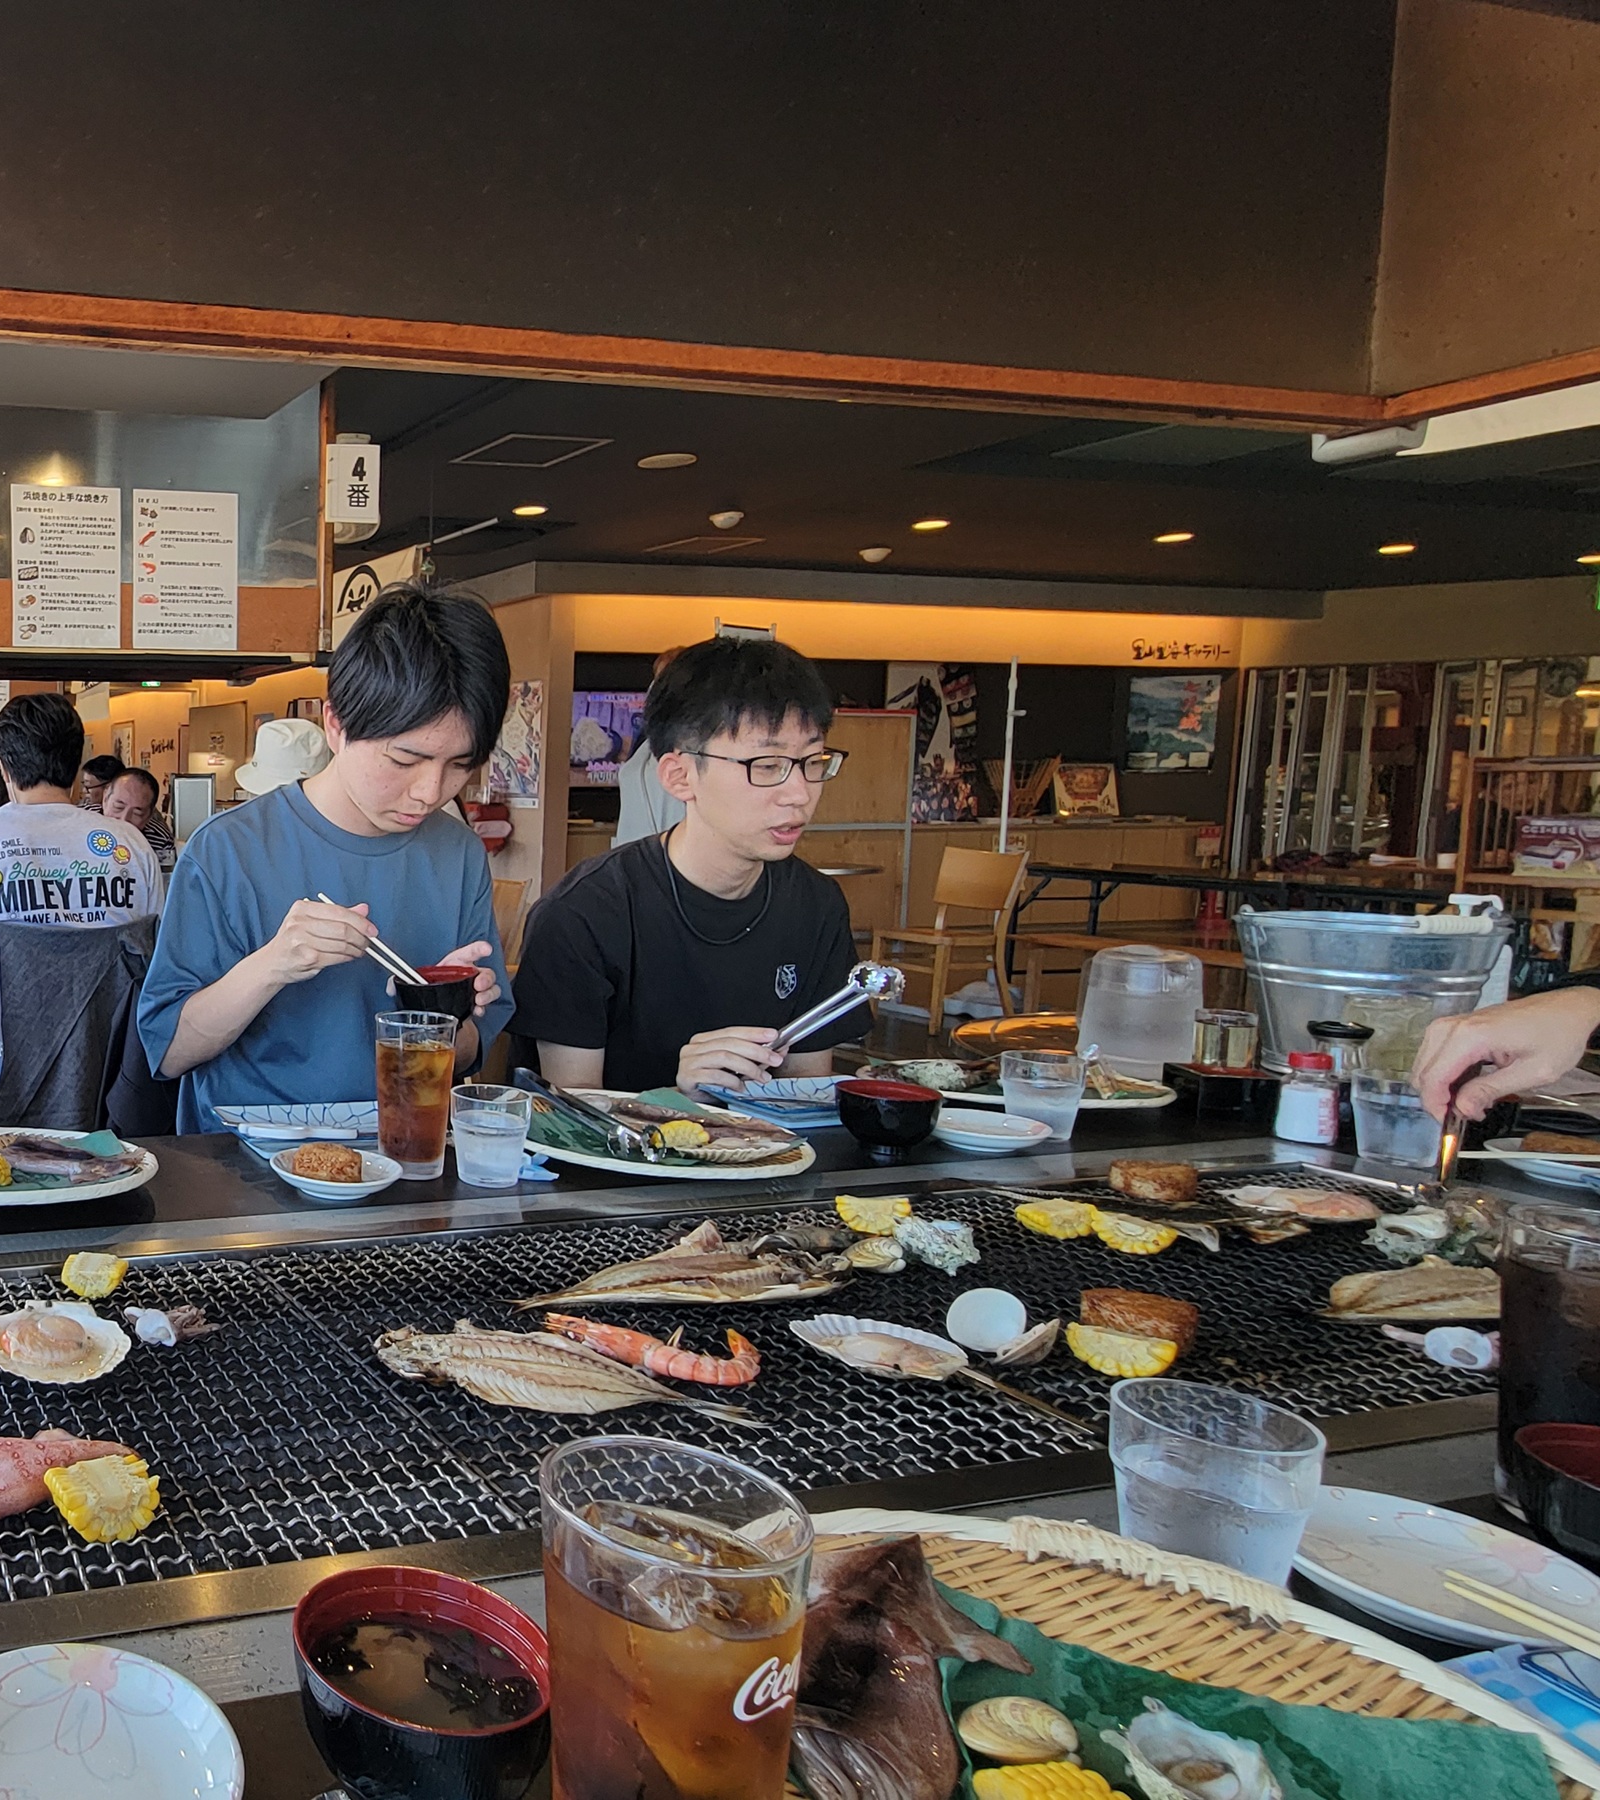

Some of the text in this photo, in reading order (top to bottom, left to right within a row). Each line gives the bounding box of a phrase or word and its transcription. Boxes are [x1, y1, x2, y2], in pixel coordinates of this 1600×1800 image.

[347, 456, 370, 507] 4番
[23, 491, 109, 504] 浜焼きの上手な焼き方
[7, 848, 30, 857] SMILES
[31, 848, 46, 856] WITH
[9, 860, 111, 882] Harvey Ball
[80, 876, 136, 909] FACE
[24, 910, 107, 924] HAVE A NICE DAY
[732, 1648, 802, 1722] Coca
